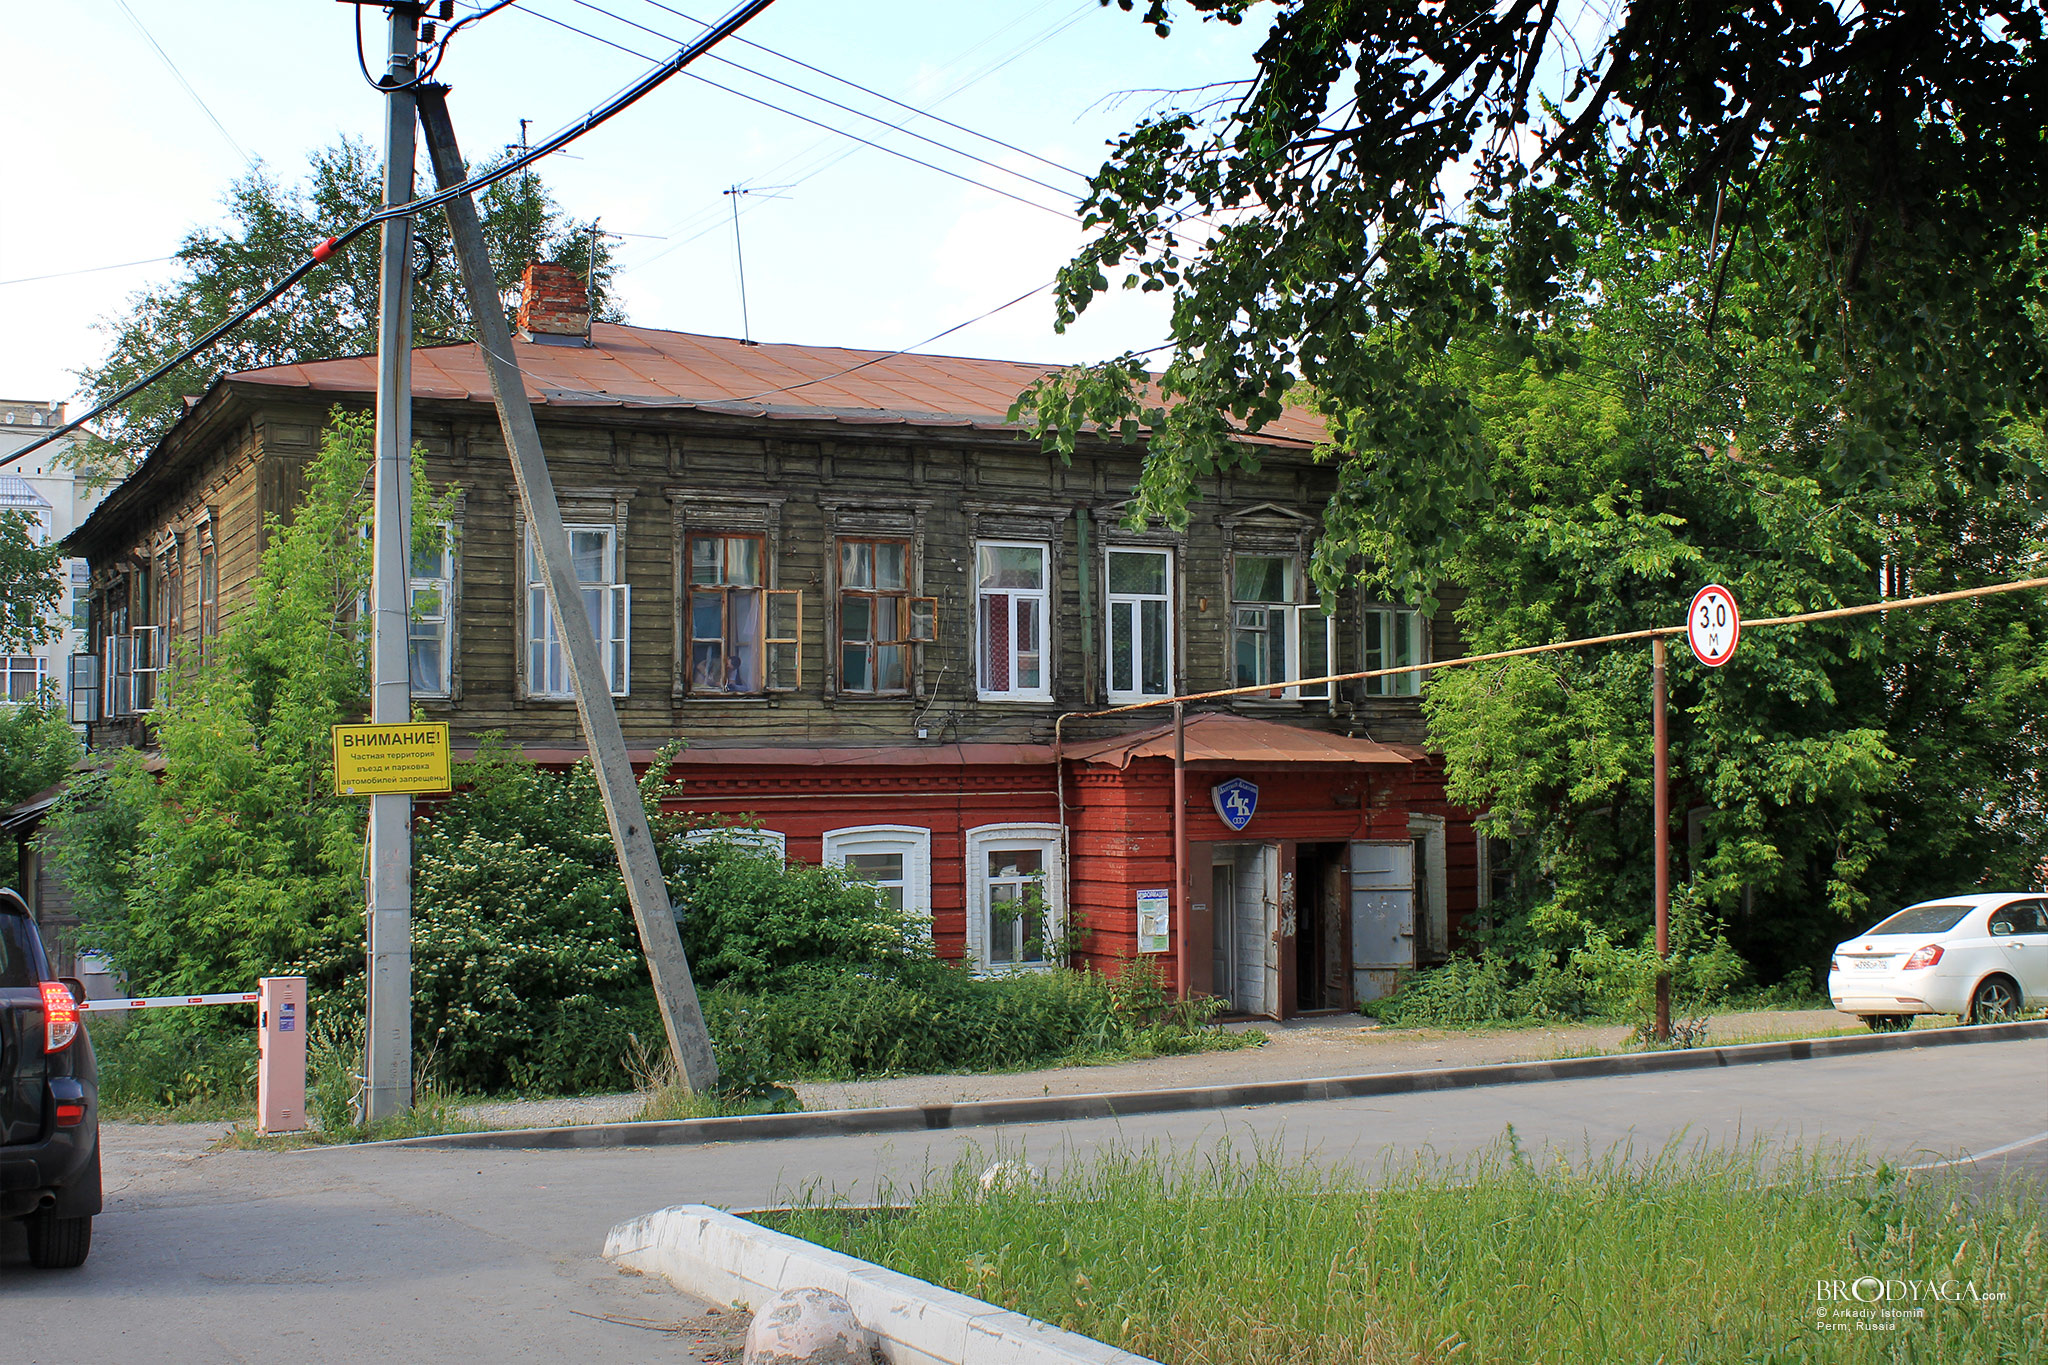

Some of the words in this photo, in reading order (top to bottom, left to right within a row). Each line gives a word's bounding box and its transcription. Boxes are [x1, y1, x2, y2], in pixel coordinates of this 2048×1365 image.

[1700, 604, 1726, 631] 3,0
[343, 731, 441, 748] ВНИМАНИЕ!
[350, 753, 385, 761] Частная
[387, 751, 435, 760] территория
[392, 763, 430, 772] парковка
[341, 776, 397, 785] автомобилей
[399, 775, 446, 784] запрещены
